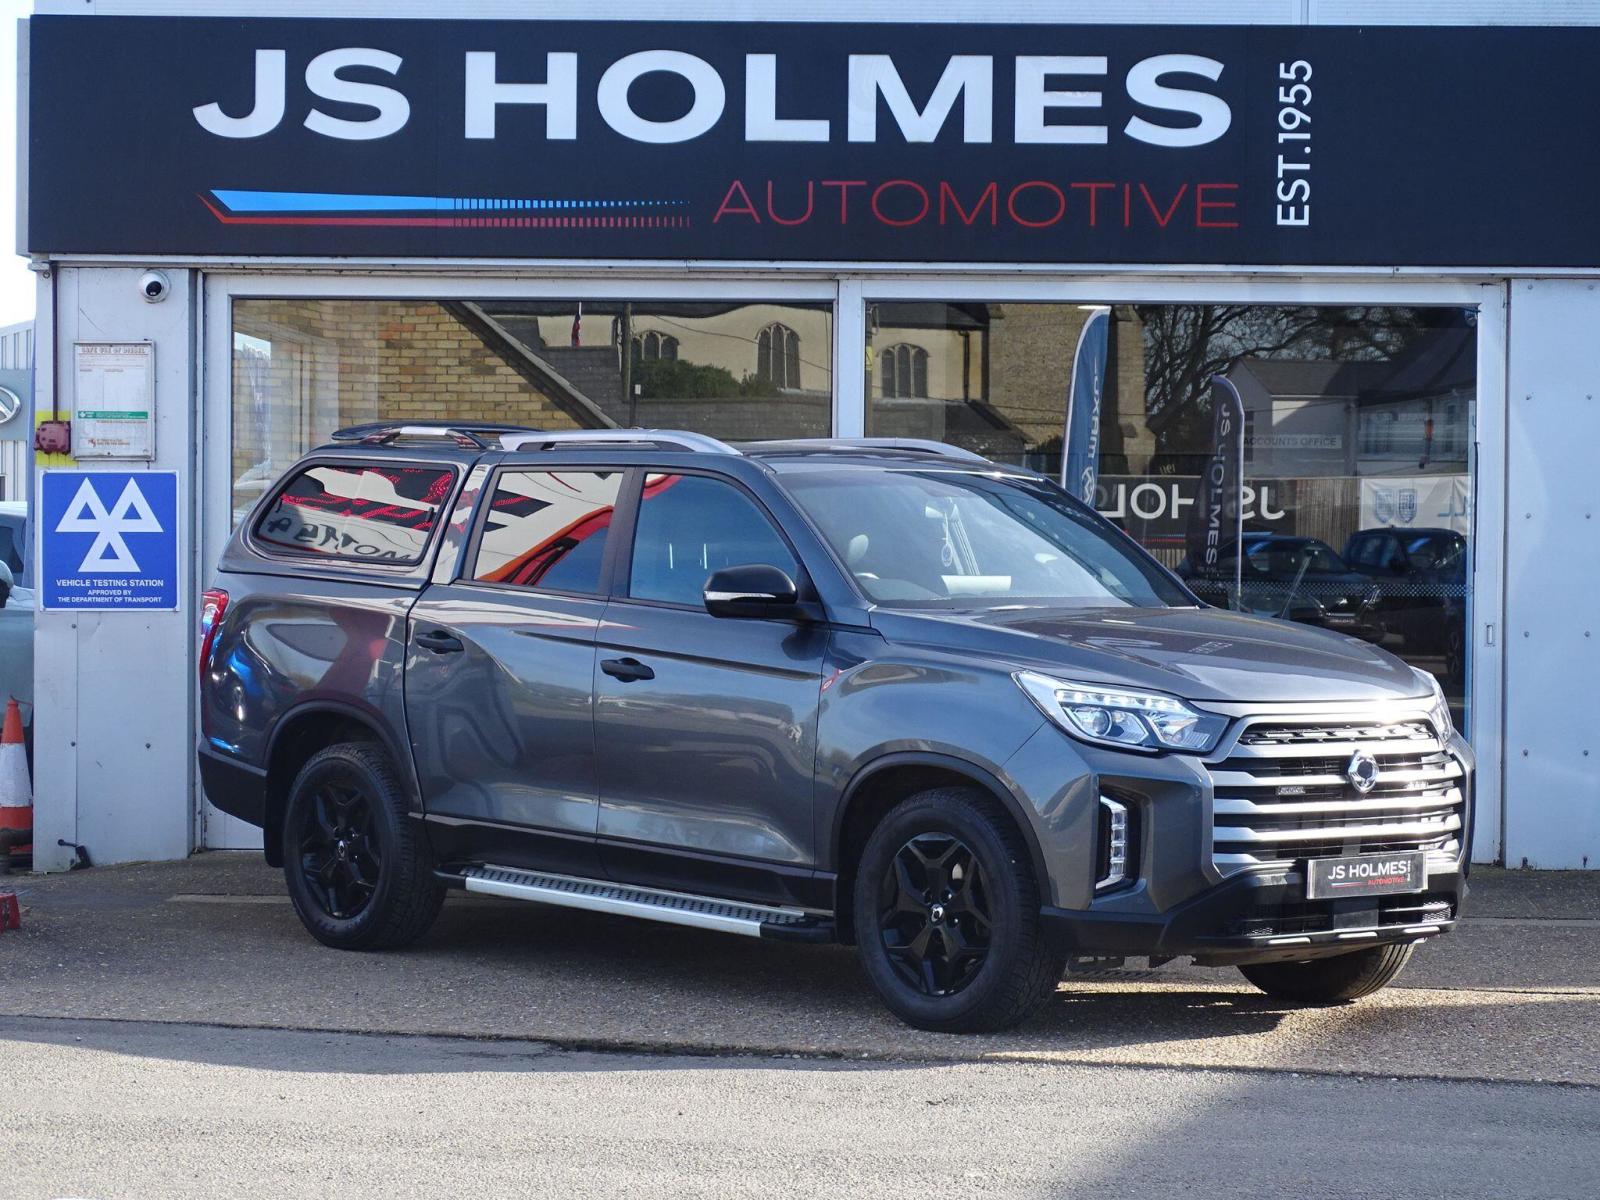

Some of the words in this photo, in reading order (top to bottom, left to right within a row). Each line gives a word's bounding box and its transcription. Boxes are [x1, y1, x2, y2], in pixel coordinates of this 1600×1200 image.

[193, 48, 410, 140] JS
[465, 50, 1231, 147] HOLMES
[1277, 60, 1312, 226] EST.1955
[712, 179, 1239, 229] AUTOMOTIVE
[56, 580, 90, 588] VEHICLE
[93, 580, 127, 588] TESTING
[129, 580, 164, 588] STATION
[1328, 865, 1346, 880] JS
[1349, 860, 1407, 878] HOLMES
